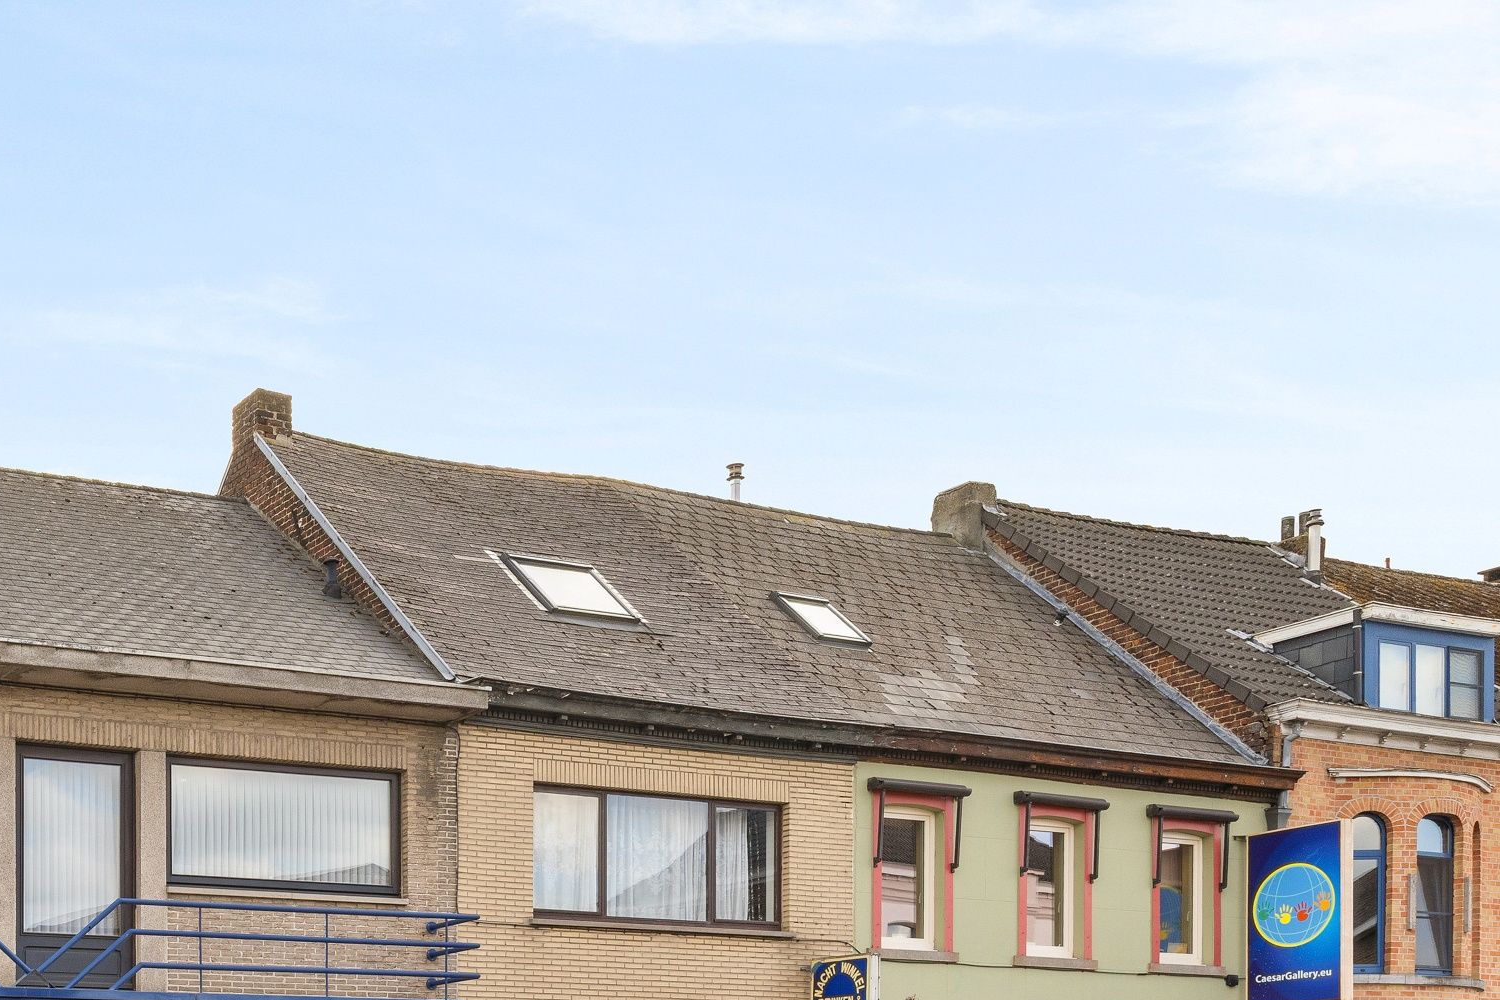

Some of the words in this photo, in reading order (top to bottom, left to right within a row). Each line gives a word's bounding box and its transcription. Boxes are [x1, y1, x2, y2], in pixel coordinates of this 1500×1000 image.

[814, 963, 837, 998] NACHT
[841, 962, 865, 994] WINKEL
[1255, 969, 1332, 983] CaesarGallery.eu
